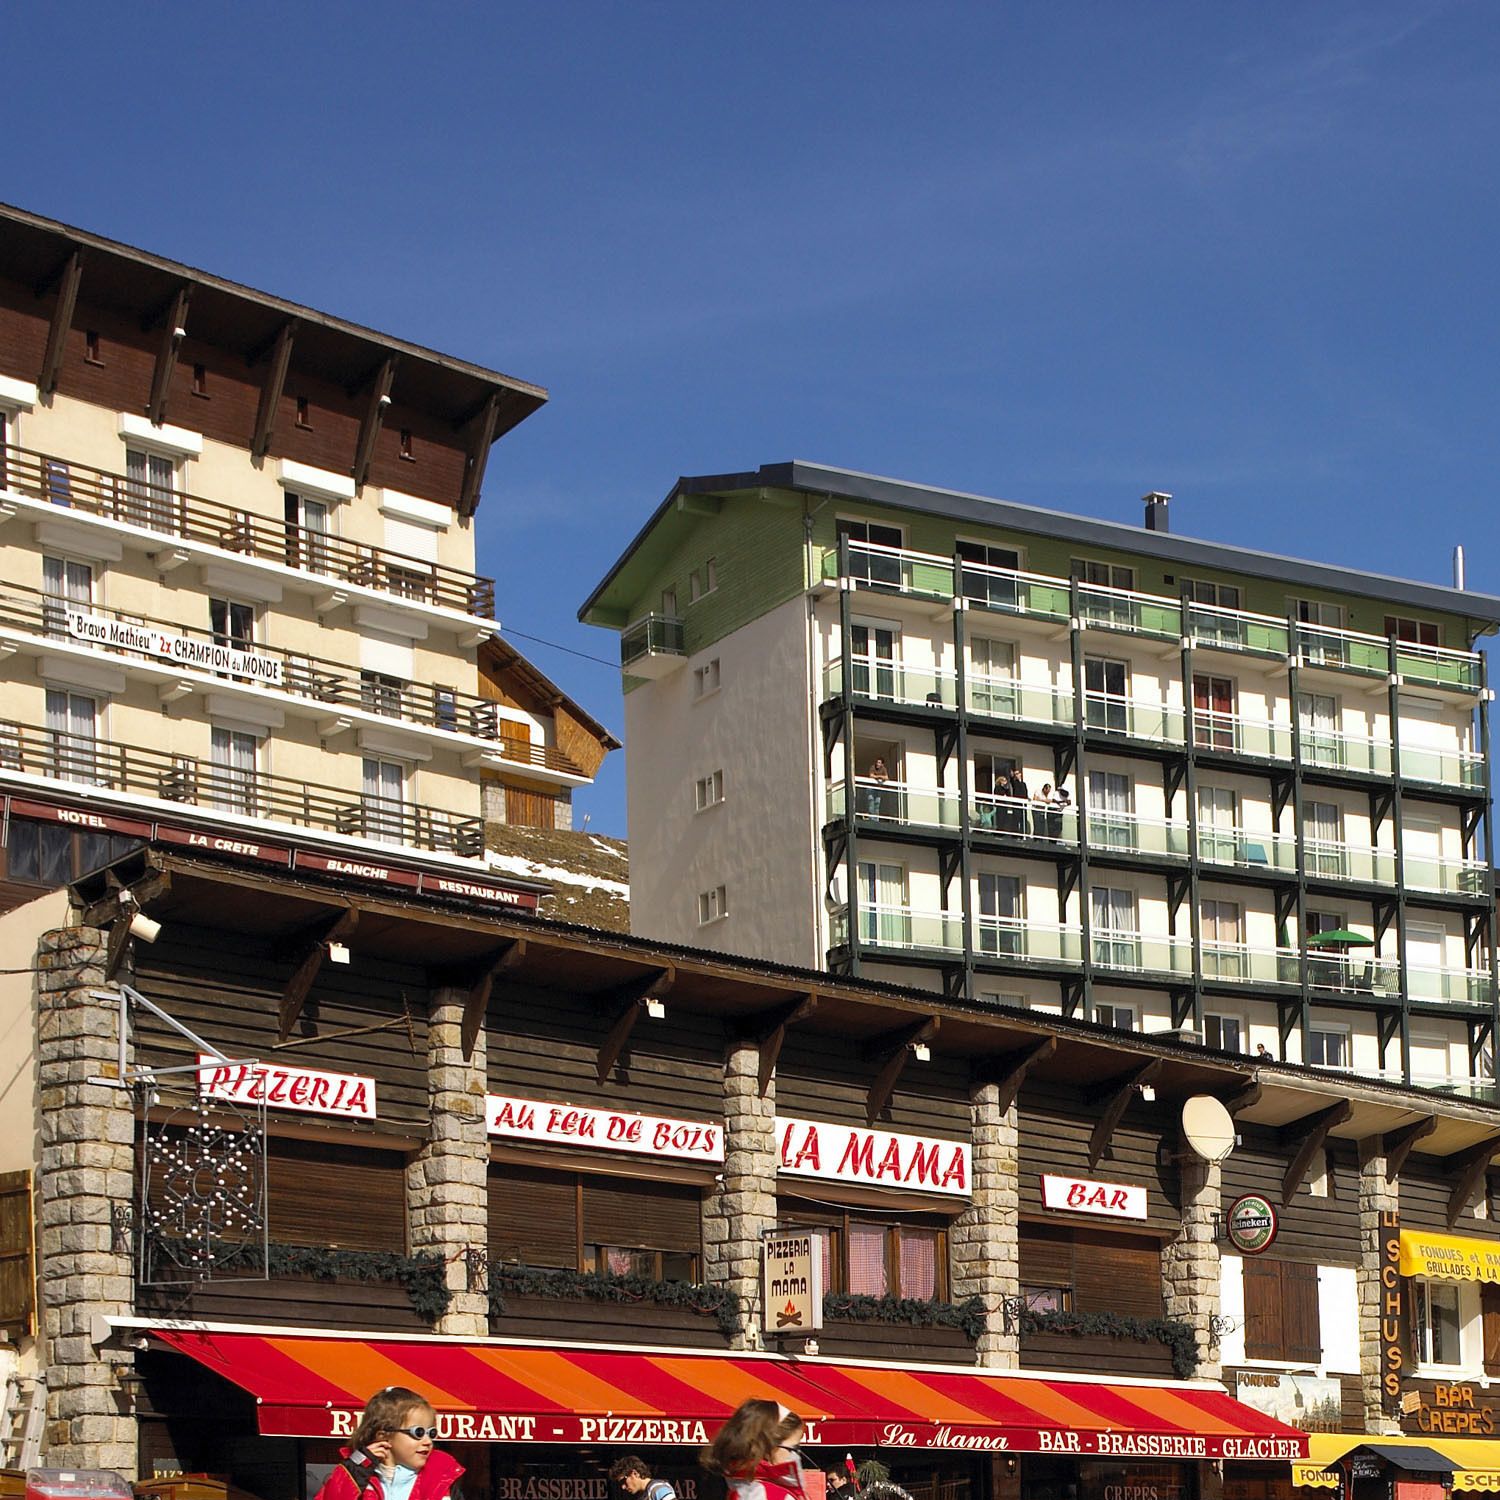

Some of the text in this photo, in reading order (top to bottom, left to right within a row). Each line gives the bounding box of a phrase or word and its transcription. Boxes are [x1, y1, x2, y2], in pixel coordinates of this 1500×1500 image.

[160, 636, 171, 654] 2x
[174, 638, 230, 669] CHAMPION
[231, 660, 241, 671] du
[242, 654, 279, 679] MONDE
[57, 809, 107, 828] HOTEL
[189, 833, 259, 856] LA CRETE
[326, 859, 389, 880] BLANCHE
[438, 880, 520, 904] RESTAURANT
[207, 1064, 368, 1114] PIZZERIA
[494, 1102, 717, 1153] AU FEU DE BOIS
[780, 1122, 966, 1190] LA MAMA
[1066, 1183, 1129, 1210] BAR
[767, 1238, 810, 1259] PIZZERIA
[1419, 1245, 1465, 1263] FONDUES
[1469, 1253, 1480, 1264] et
[784, 1261, 795, 1275] LA
[1426, 1260, 1472, 1277] GRILLADES
[1486, 1269, 1498, 1280] LA
[771, 1277, 807, 1296] MAMA
[1382, 1239, 1402, 1397] SCHUSS
[1435, 1384, 1474, 1408] BAR
[579, 1418, 710, 1444] PIZZERIA
[880, 1423, 1010, 1450] La Mama
[1038, 1431, 1082, 1452] BAR
[1097, 1433, 1207, 1456] BRASSERIE
[1222, 1438, 1302, 1458] GLACIER
[500, 1476, 698, 1500] BRASSERIE AR
